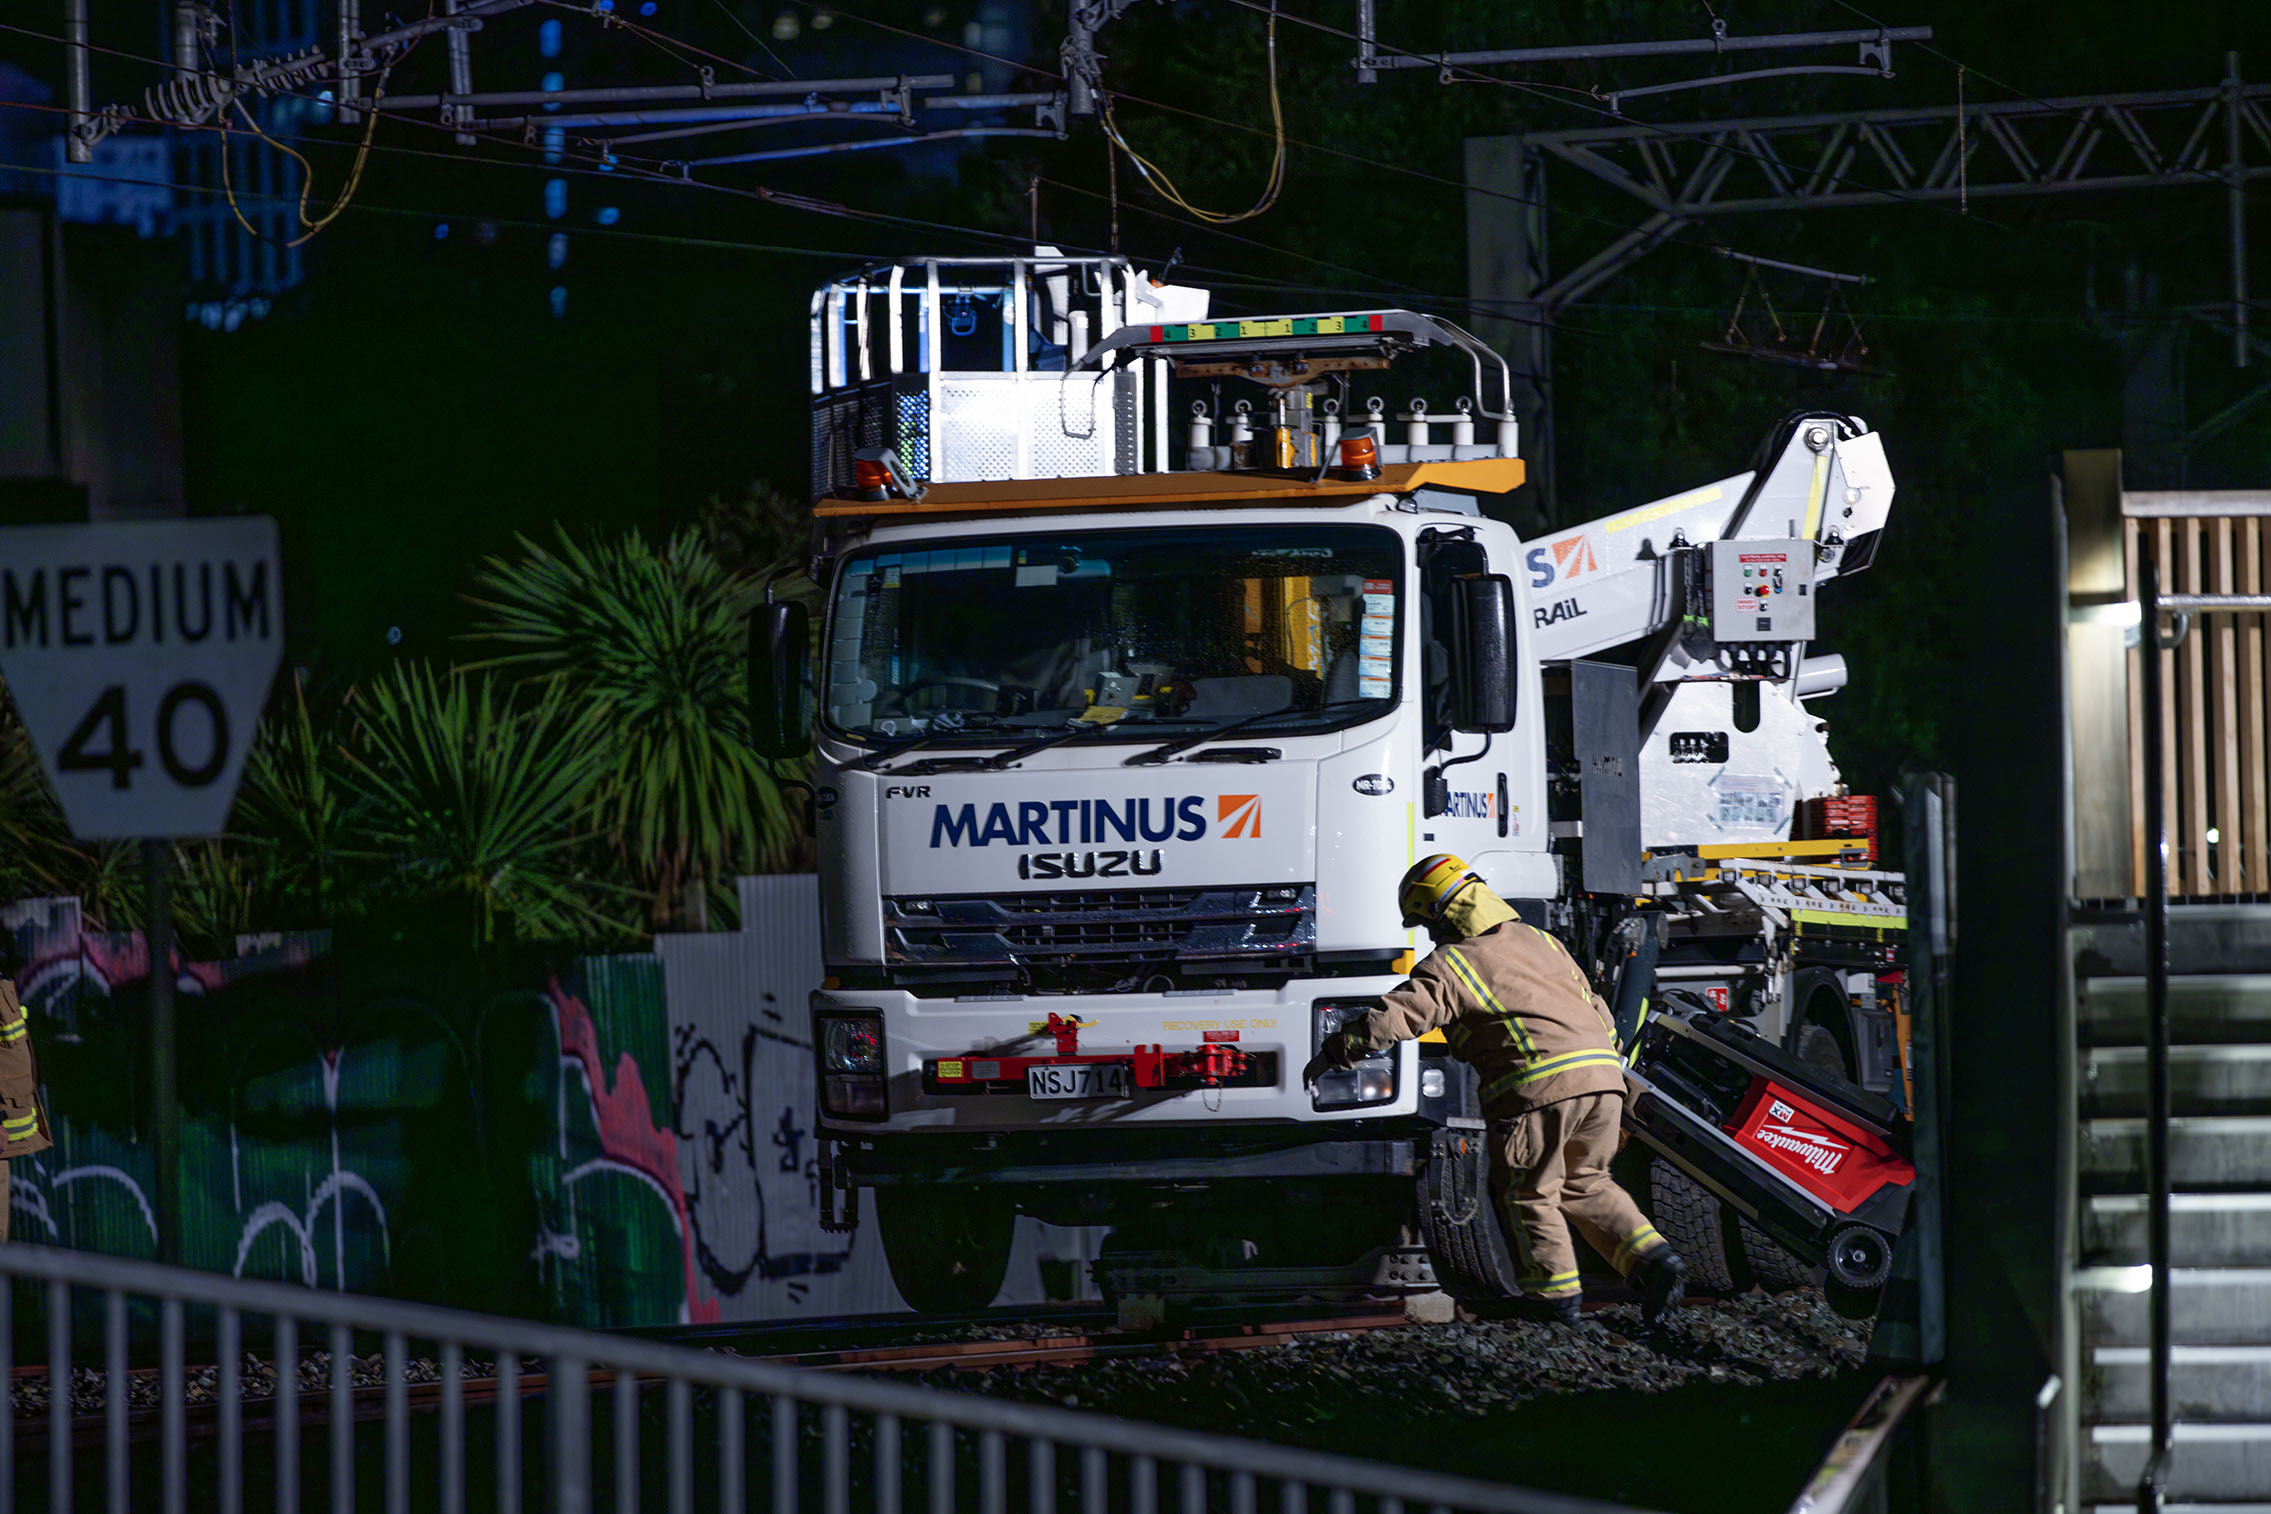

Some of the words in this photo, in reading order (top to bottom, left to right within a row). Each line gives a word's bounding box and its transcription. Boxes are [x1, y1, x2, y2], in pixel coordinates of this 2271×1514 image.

[4, 559, 270, 648] MEDIUM
[57, 680, 229, 790] 40
[886, 785, 931, 799] FVR
[1444, 791, 1487, 818] ARTINUS
[929, 796, 1207, 848] MARTINUS
[1018, 849, 1165, 880] ISUZU
[1162, 1019, 1220, 1031] RECOVERY
[1223, 1019, 1248, 1030] USE
[1249, 1018, 1278, 1029] ONLY
[1032, 1065, 1122, 1095] NSJ714
[1771, 1106, 1790, 1121] MX
[1756, 1129, 1842, 1175] Milwaukee
